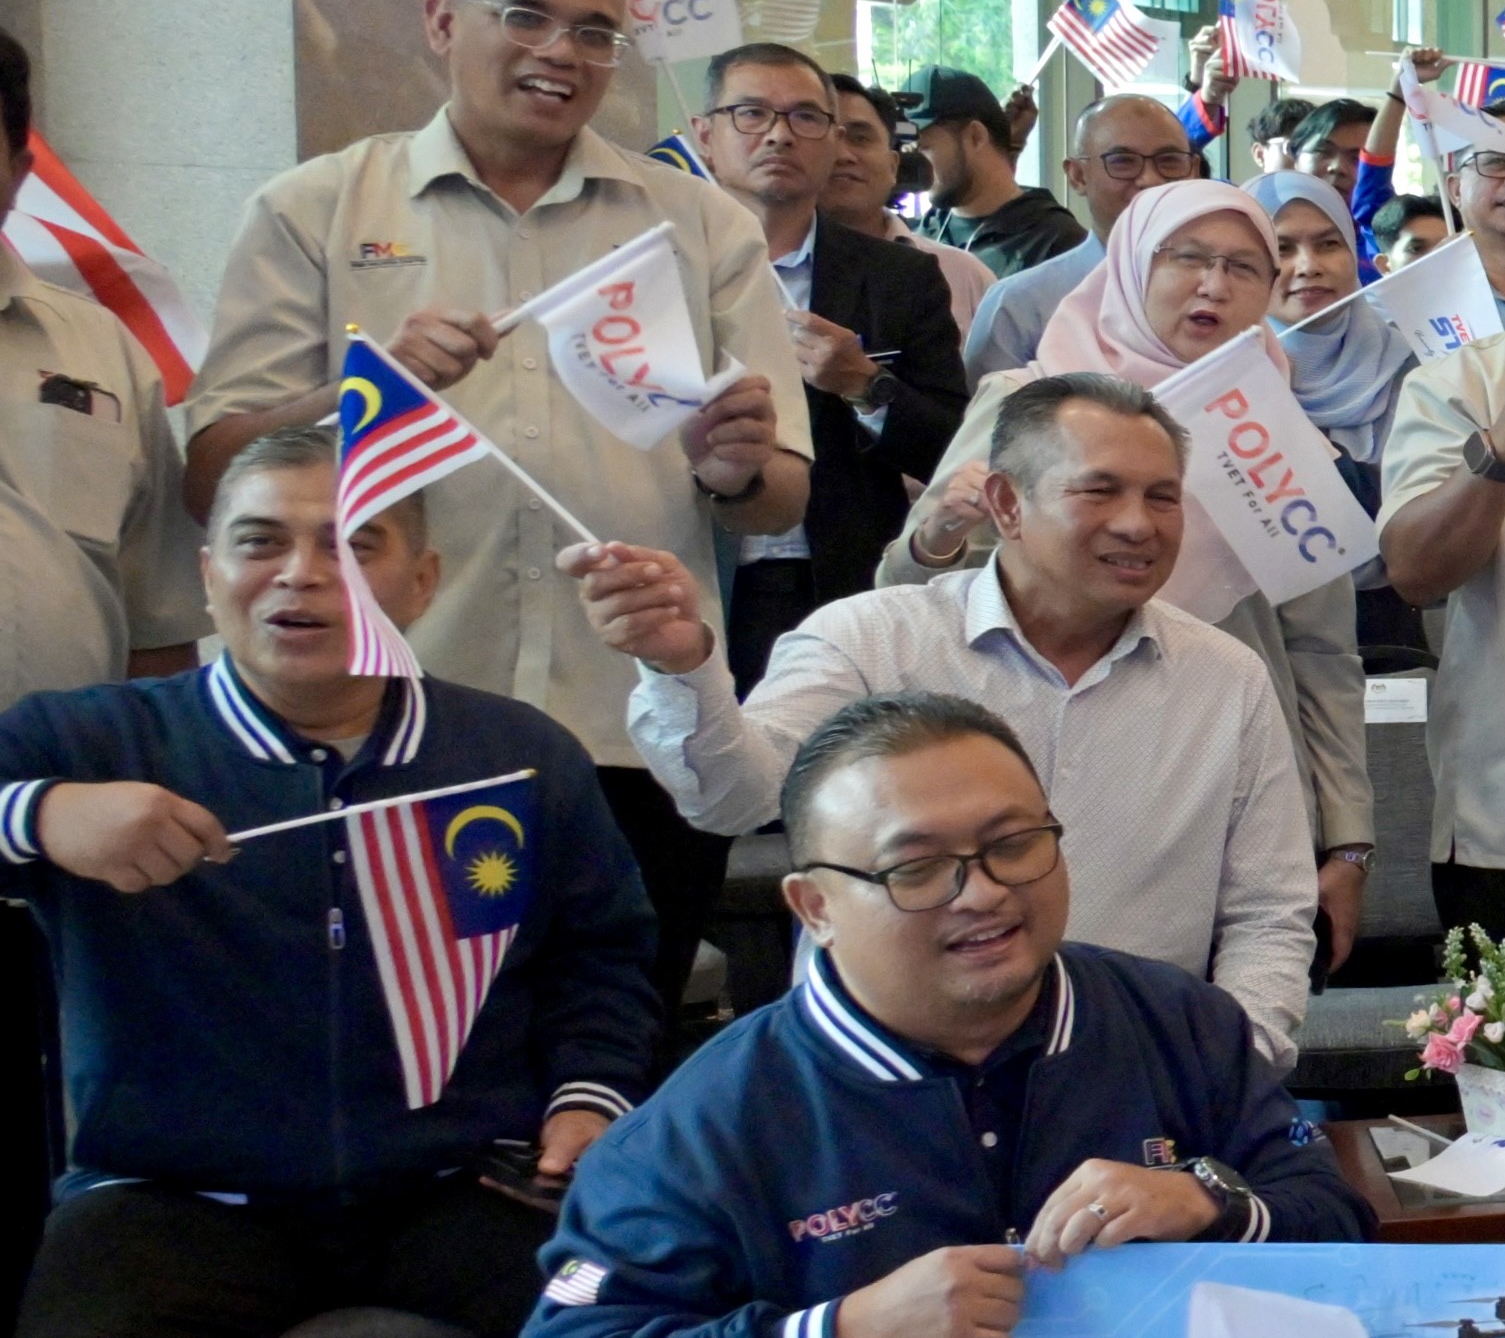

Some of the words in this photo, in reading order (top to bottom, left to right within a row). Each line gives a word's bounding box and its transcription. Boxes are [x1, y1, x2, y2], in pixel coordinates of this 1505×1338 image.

[1216, 450, 1246, 489] TVET
[1240, 484, 1262, 513] For
[1259, 510, 1280, 539] All
[788, 1191, 899, 1243] POLYCC
